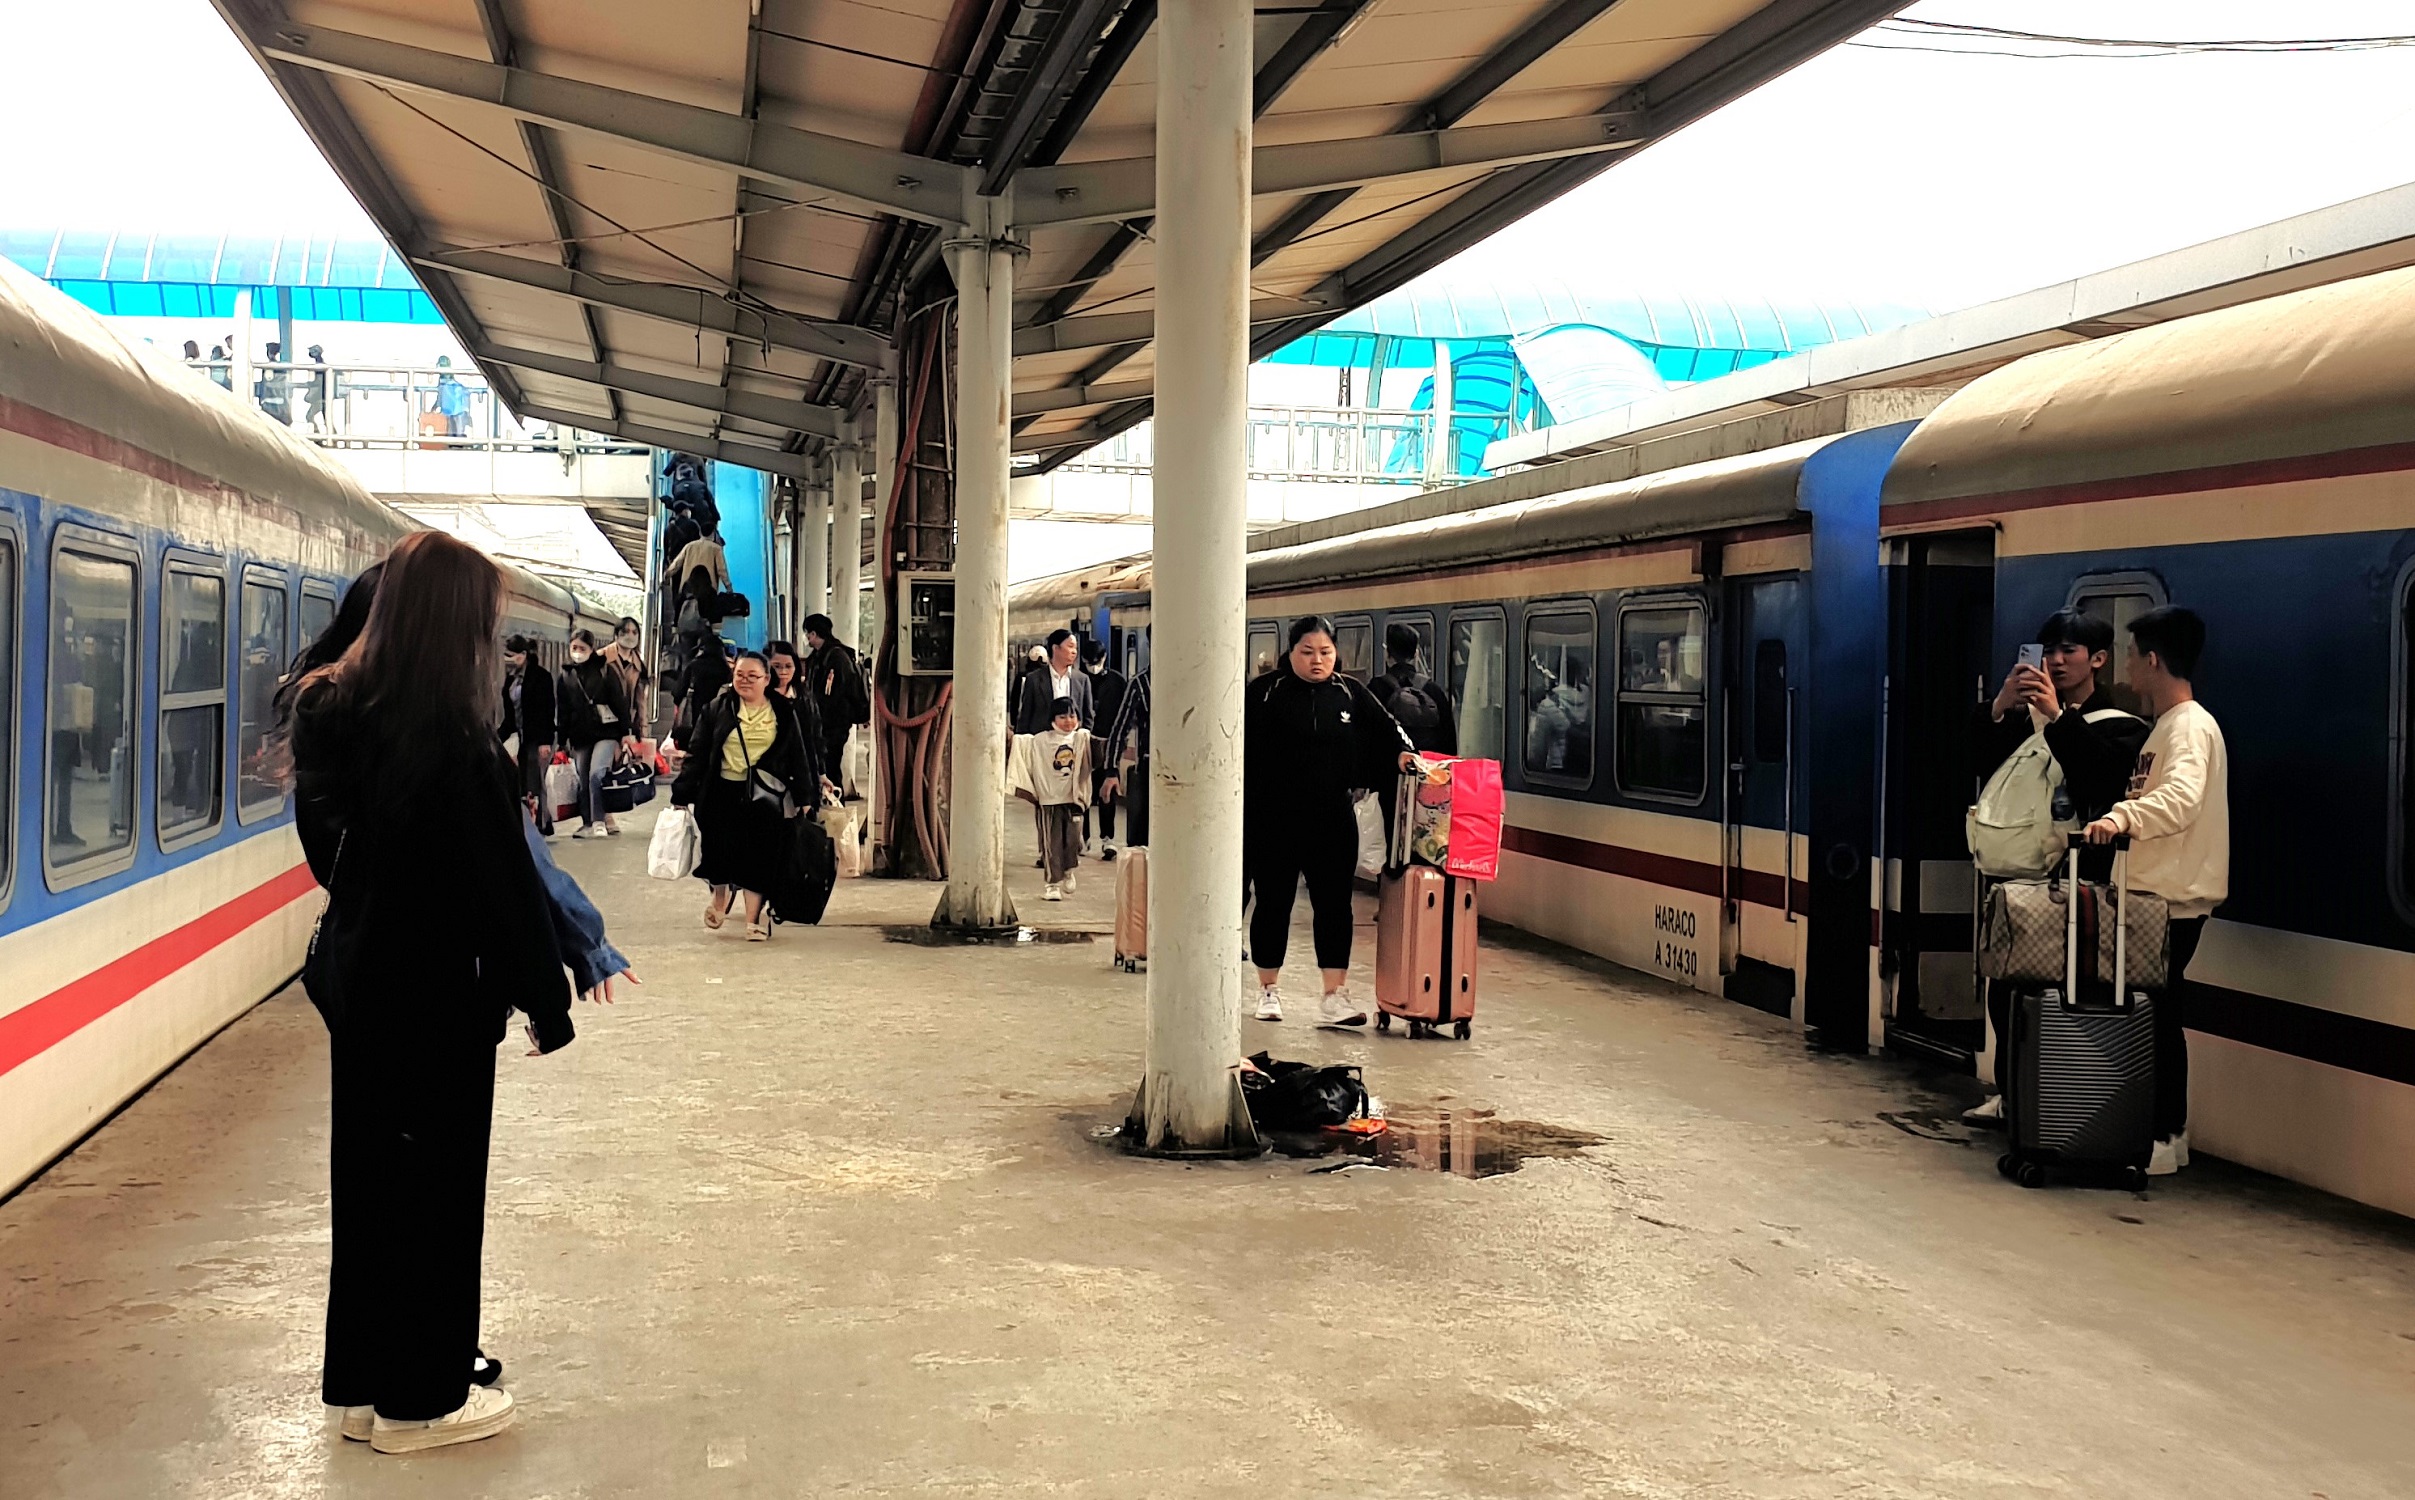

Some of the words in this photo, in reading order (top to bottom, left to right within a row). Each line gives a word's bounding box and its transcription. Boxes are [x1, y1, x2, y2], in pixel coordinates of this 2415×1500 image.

[1655, 904, 1696, 938] HARACO
[1655, 940, 1662, 966] A
[1665, 943, 1697, 976] 31430
